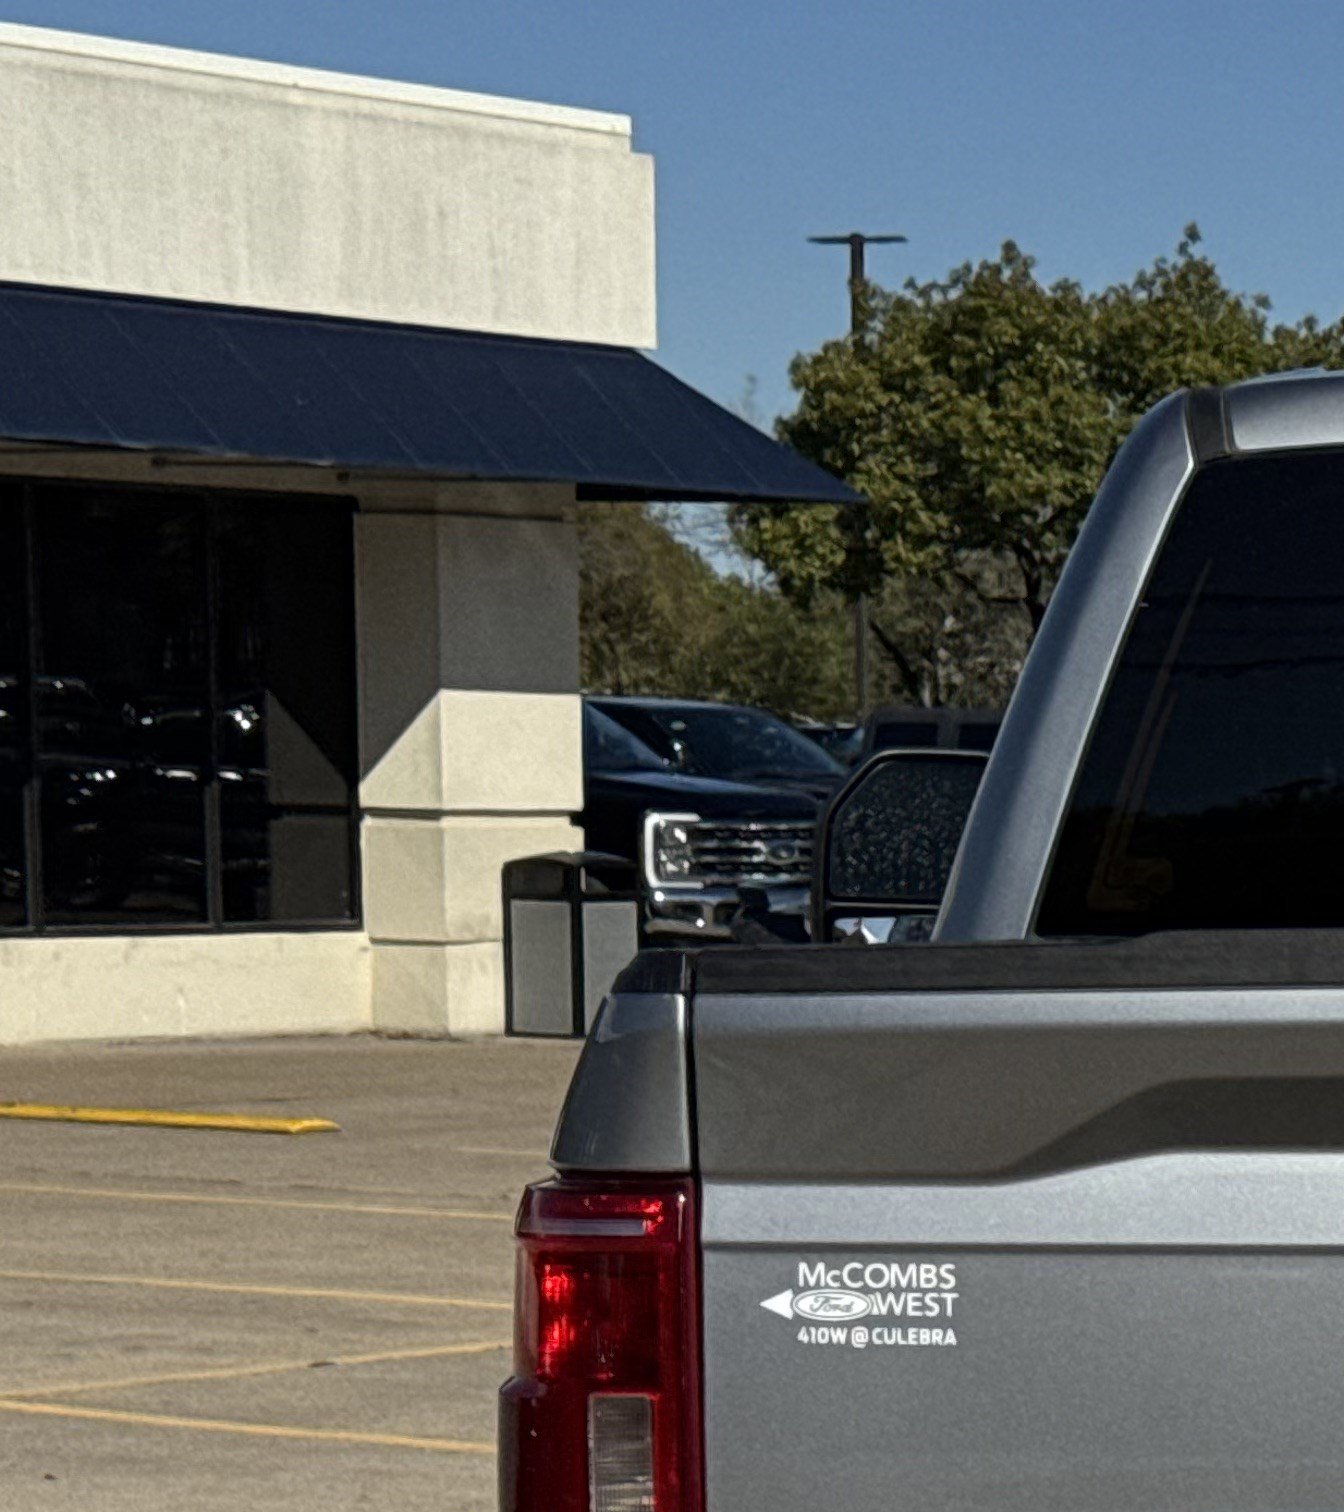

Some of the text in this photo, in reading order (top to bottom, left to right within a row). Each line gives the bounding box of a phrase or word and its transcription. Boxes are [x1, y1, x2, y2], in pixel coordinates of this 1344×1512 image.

[798, 1262, 956, 1289] McCOMBS
[809, 1291, 959, 1317] Ford WEST
[872, 1327, 957, 1345] CULEBRA
